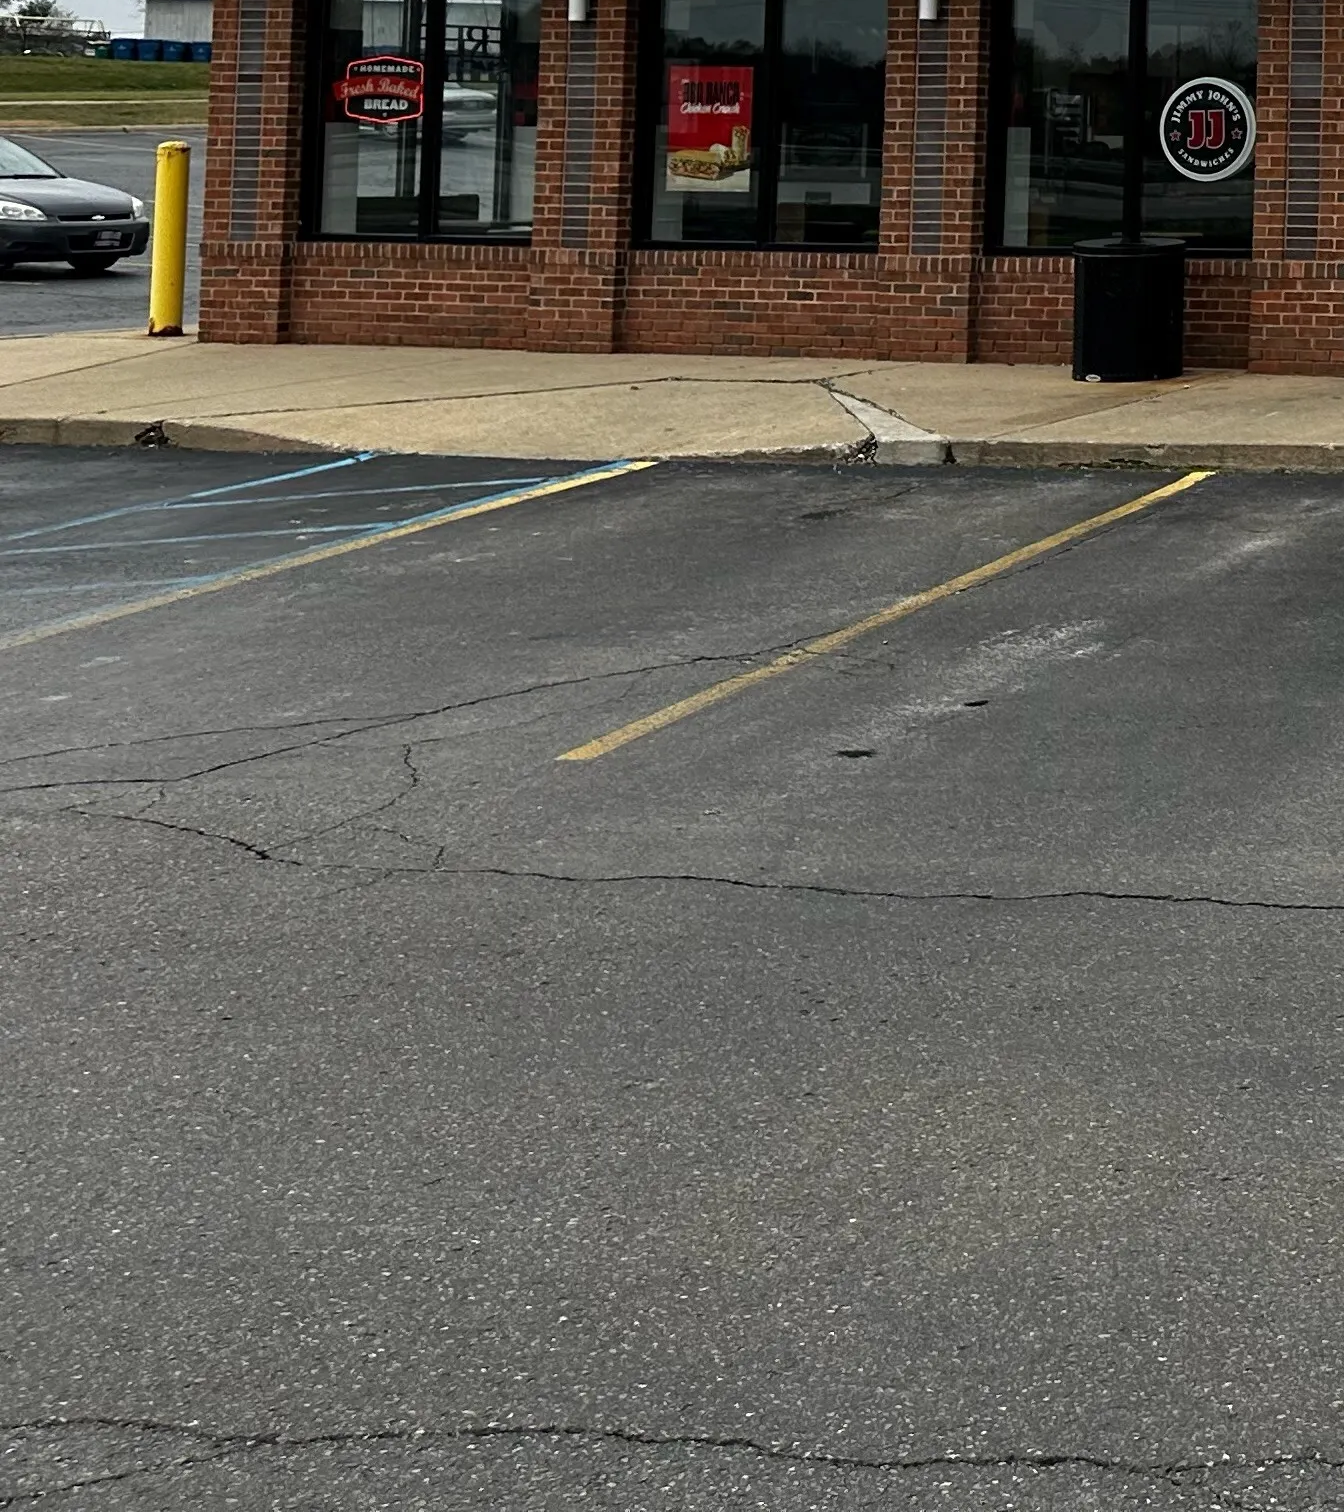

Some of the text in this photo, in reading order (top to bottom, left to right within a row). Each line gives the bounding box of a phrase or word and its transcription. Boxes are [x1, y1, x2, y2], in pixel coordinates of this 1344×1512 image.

[359, 65, 415, 73] HOMEMADE
[340, 78, 420, 99] Fresh Baked
[363, 98, 409, 110] BREAD
[1170, 90, 1241, 124] JIMMY JOHN'S
[1187, 109, 1226, 149] JJ
[1178, 148, 1234, 168] SANDWICHES
